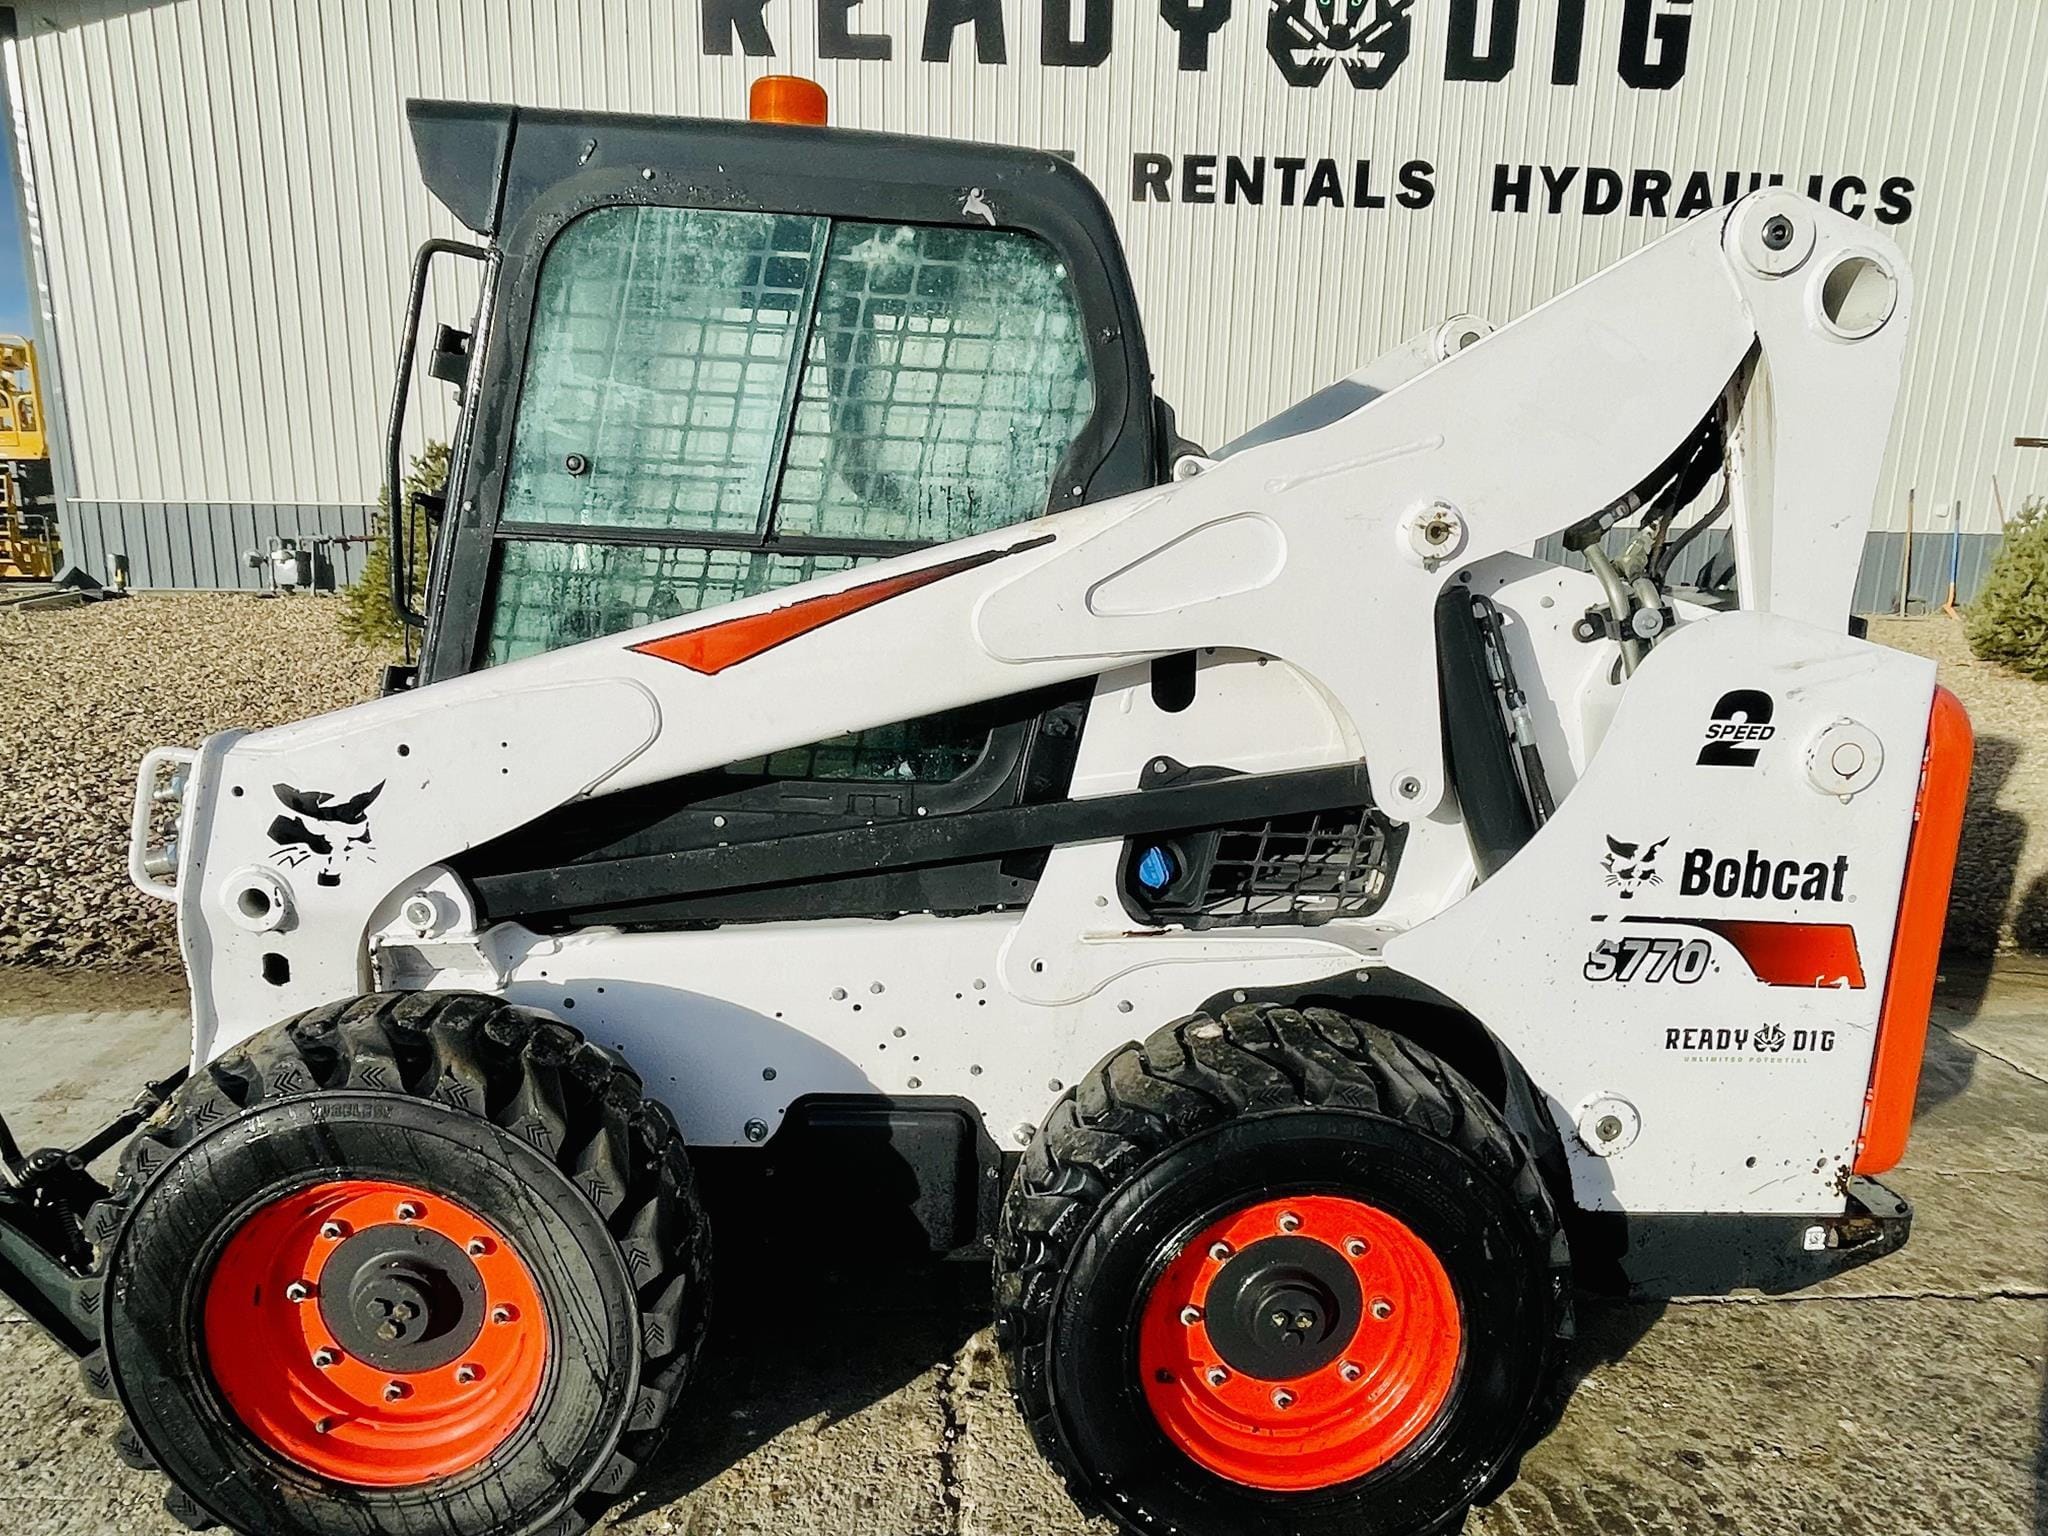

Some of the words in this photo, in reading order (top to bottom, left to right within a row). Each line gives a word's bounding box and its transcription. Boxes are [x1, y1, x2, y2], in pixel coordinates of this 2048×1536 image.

[1444, 0, 1694, 90] DIG
[1133, 152, 1435, 210] RENTALS
[1490, 163, 1915, 226] HYDRAICS
[1695, 689, 1774, 767] 2
[1705, 724, 1776, 741] SPEED
[1680, 848, 1849, 902] Bobcat
[1583, 936, 1712, 984] S770
[1665, 1028, 1749, 1051] READY
[1792, 1030, 1836, 1052] DIG
